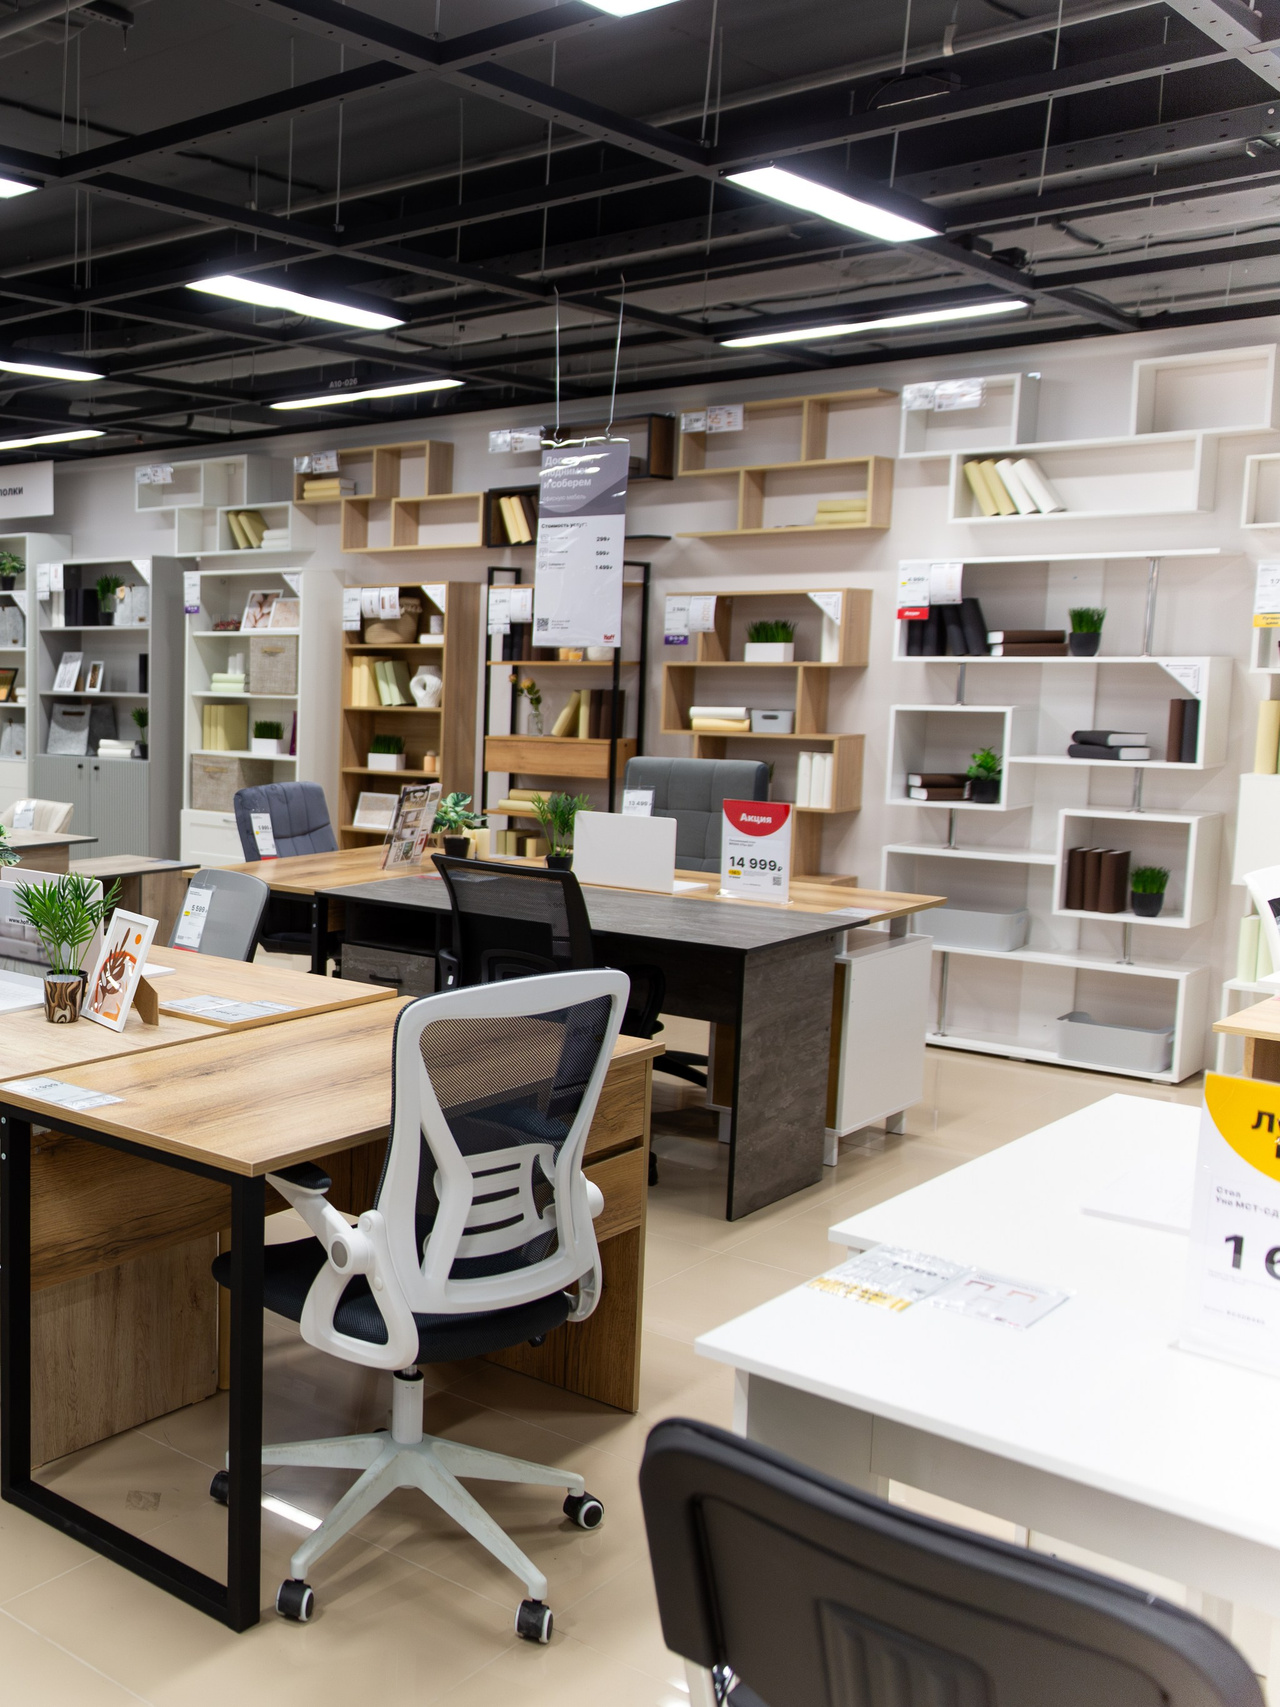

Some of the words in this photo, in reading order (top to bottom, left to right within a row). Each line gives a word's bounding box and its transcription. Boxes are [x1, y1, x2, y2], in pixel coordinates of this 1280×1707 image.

[551, 478, 591, 489] соберем
[740, 813, 772, 824] Акция
[729, 856, 745, 868] 14
